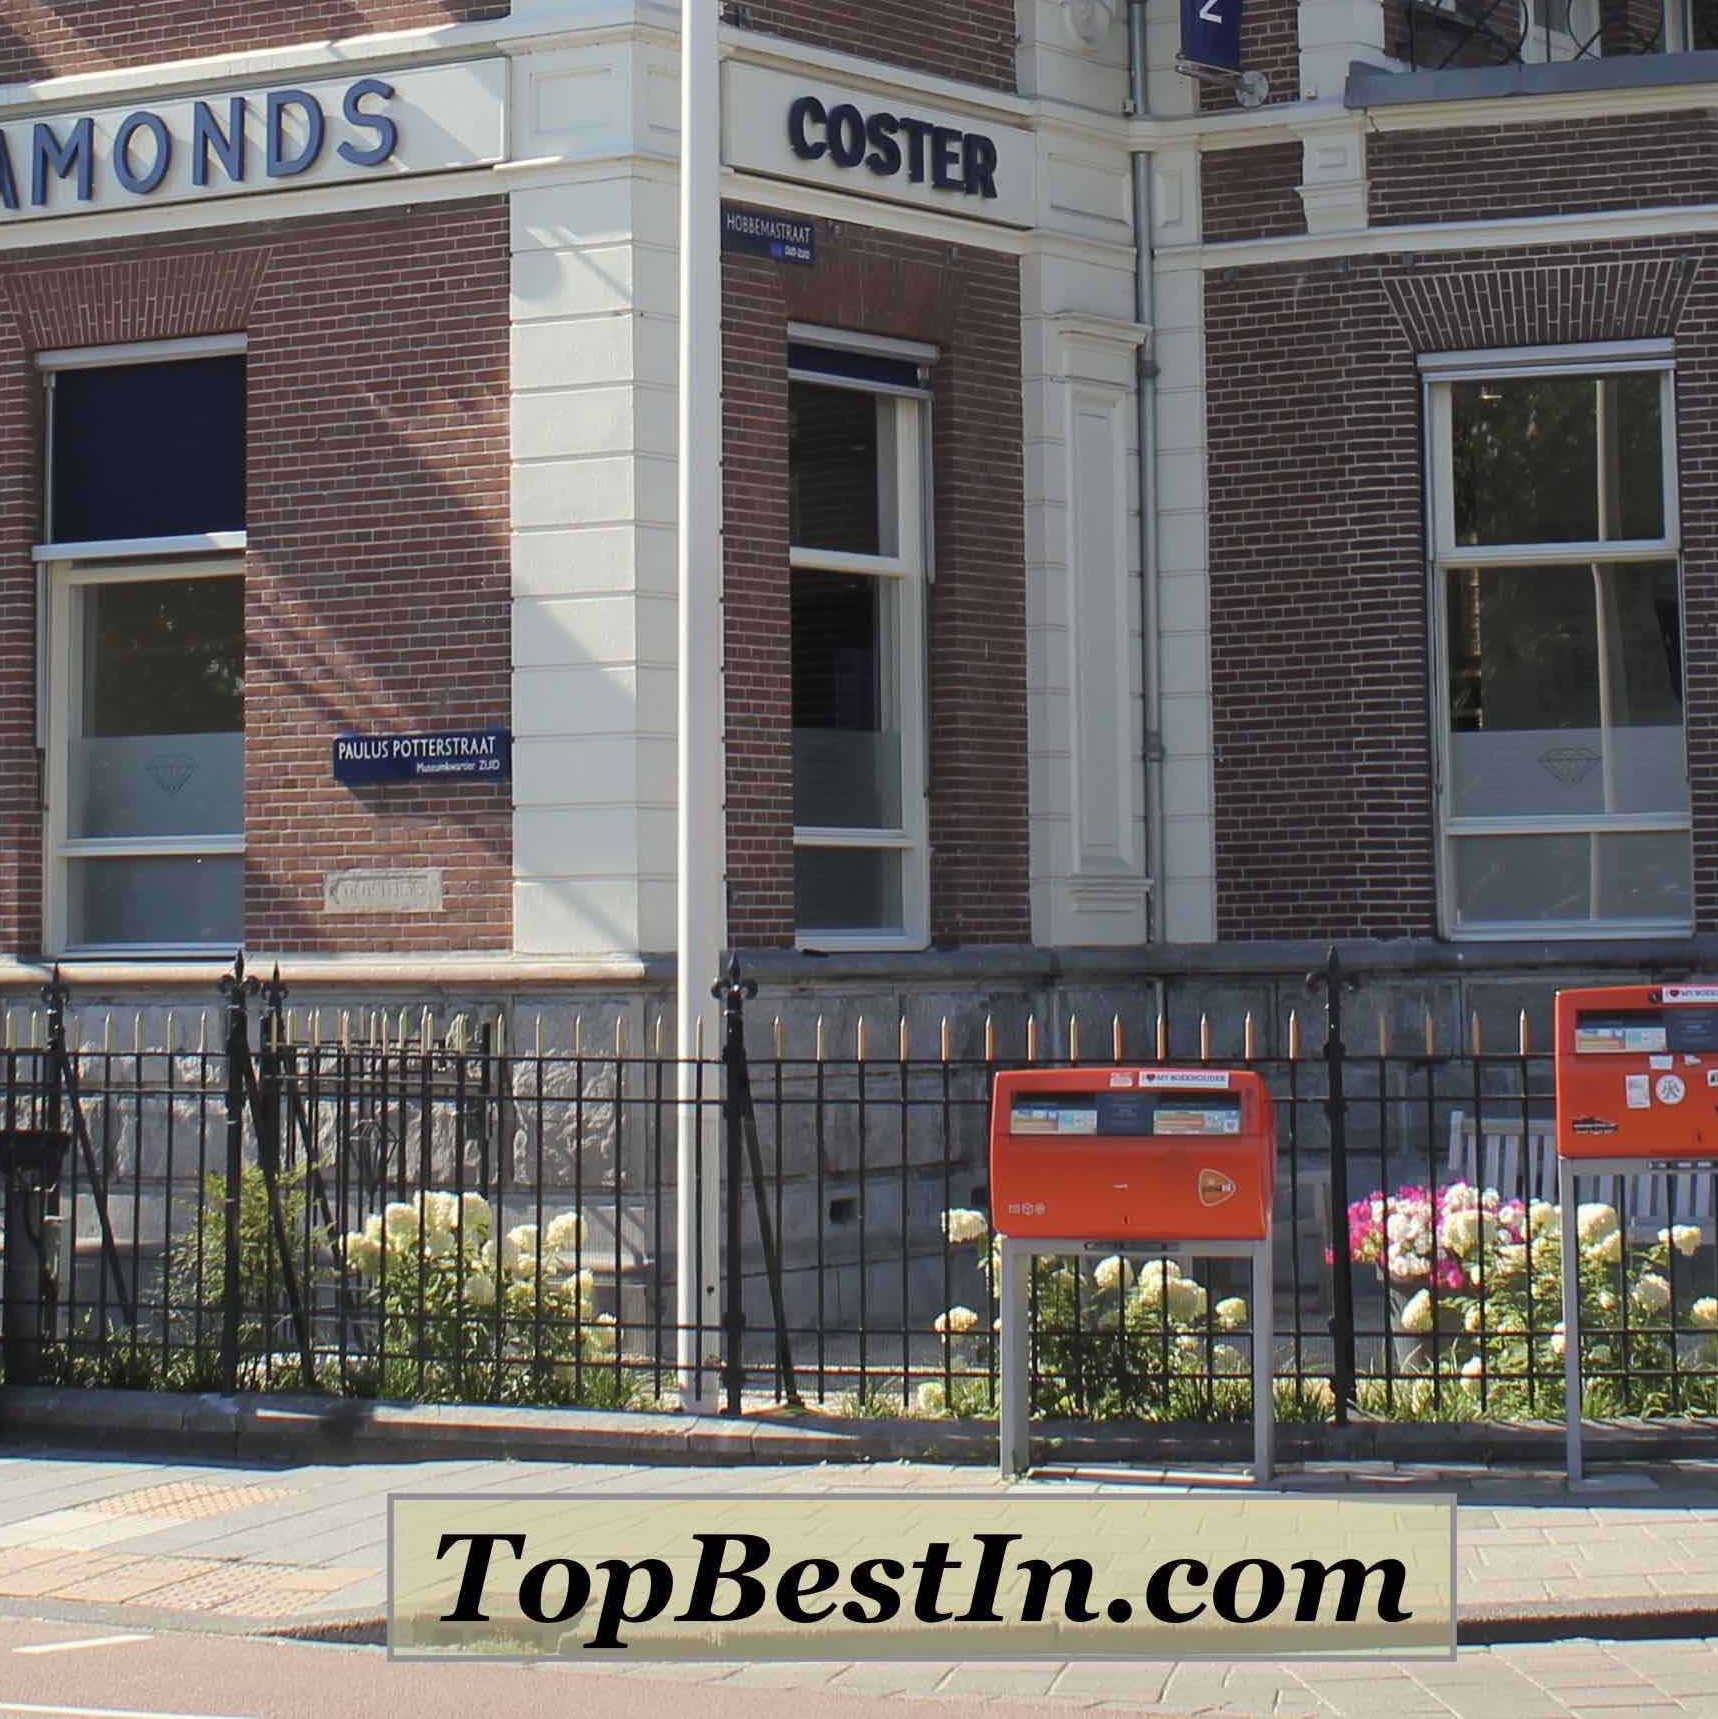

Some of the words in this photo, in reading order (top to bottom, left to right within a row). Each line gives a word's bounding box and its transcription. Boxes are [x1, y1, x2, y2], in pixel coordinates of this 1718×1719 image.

[787, 95, 999, 200] COSTER
[726, 212, 812, 243] HOBBEMASTRAAT
[338, 740, 389, 761] PAULUS
[392, 735, 497, 759] POTTERSTRAAT
